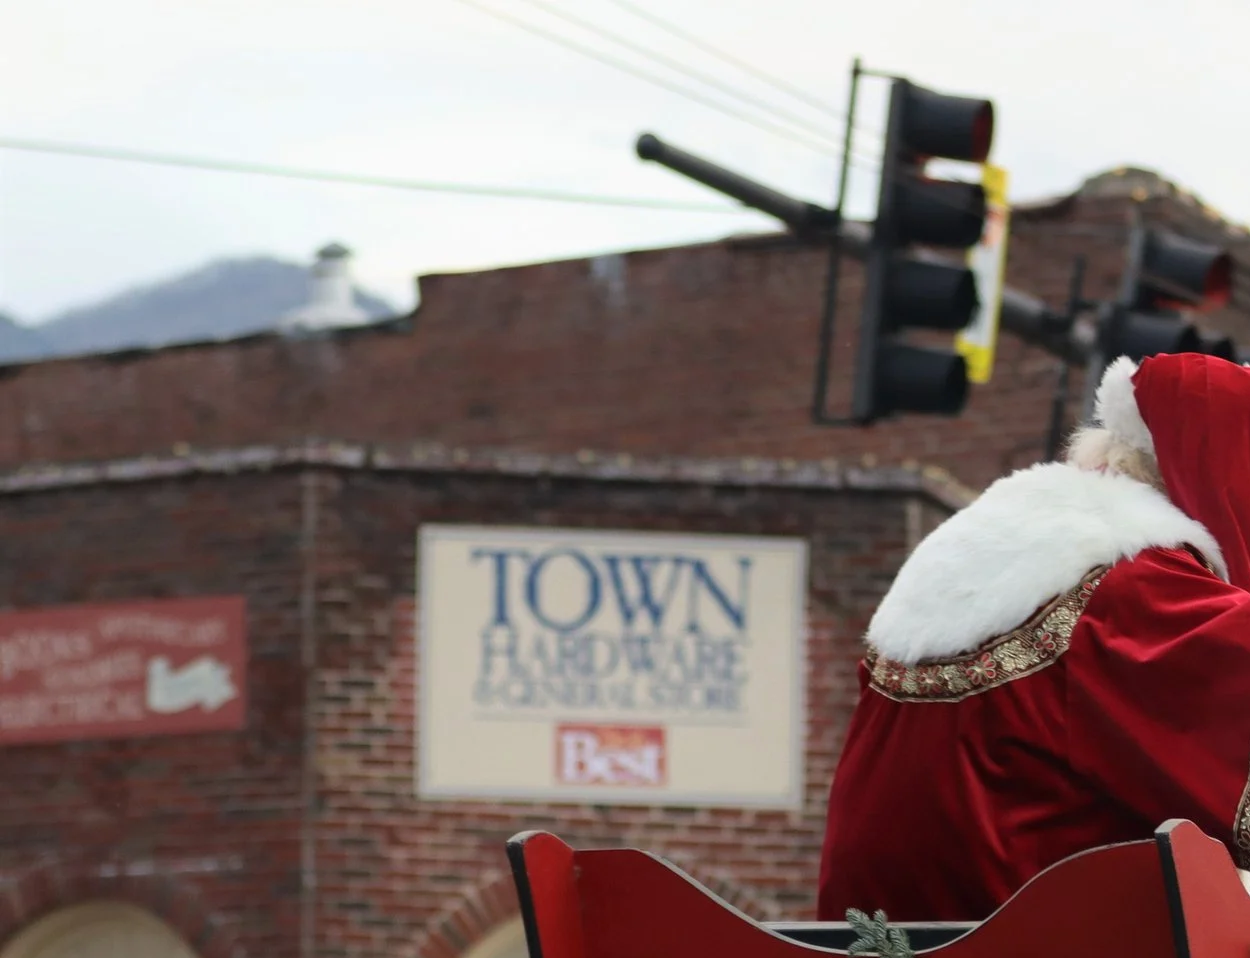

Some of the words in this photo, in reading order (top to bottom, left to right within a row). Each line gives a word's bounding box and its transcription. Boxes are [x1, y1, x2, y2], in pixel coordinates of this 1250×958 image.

[469, 547, 754, 633] TOWN
[480, 626, 750, 686] HARDWARE
[561, 731, 660, 784] Best
